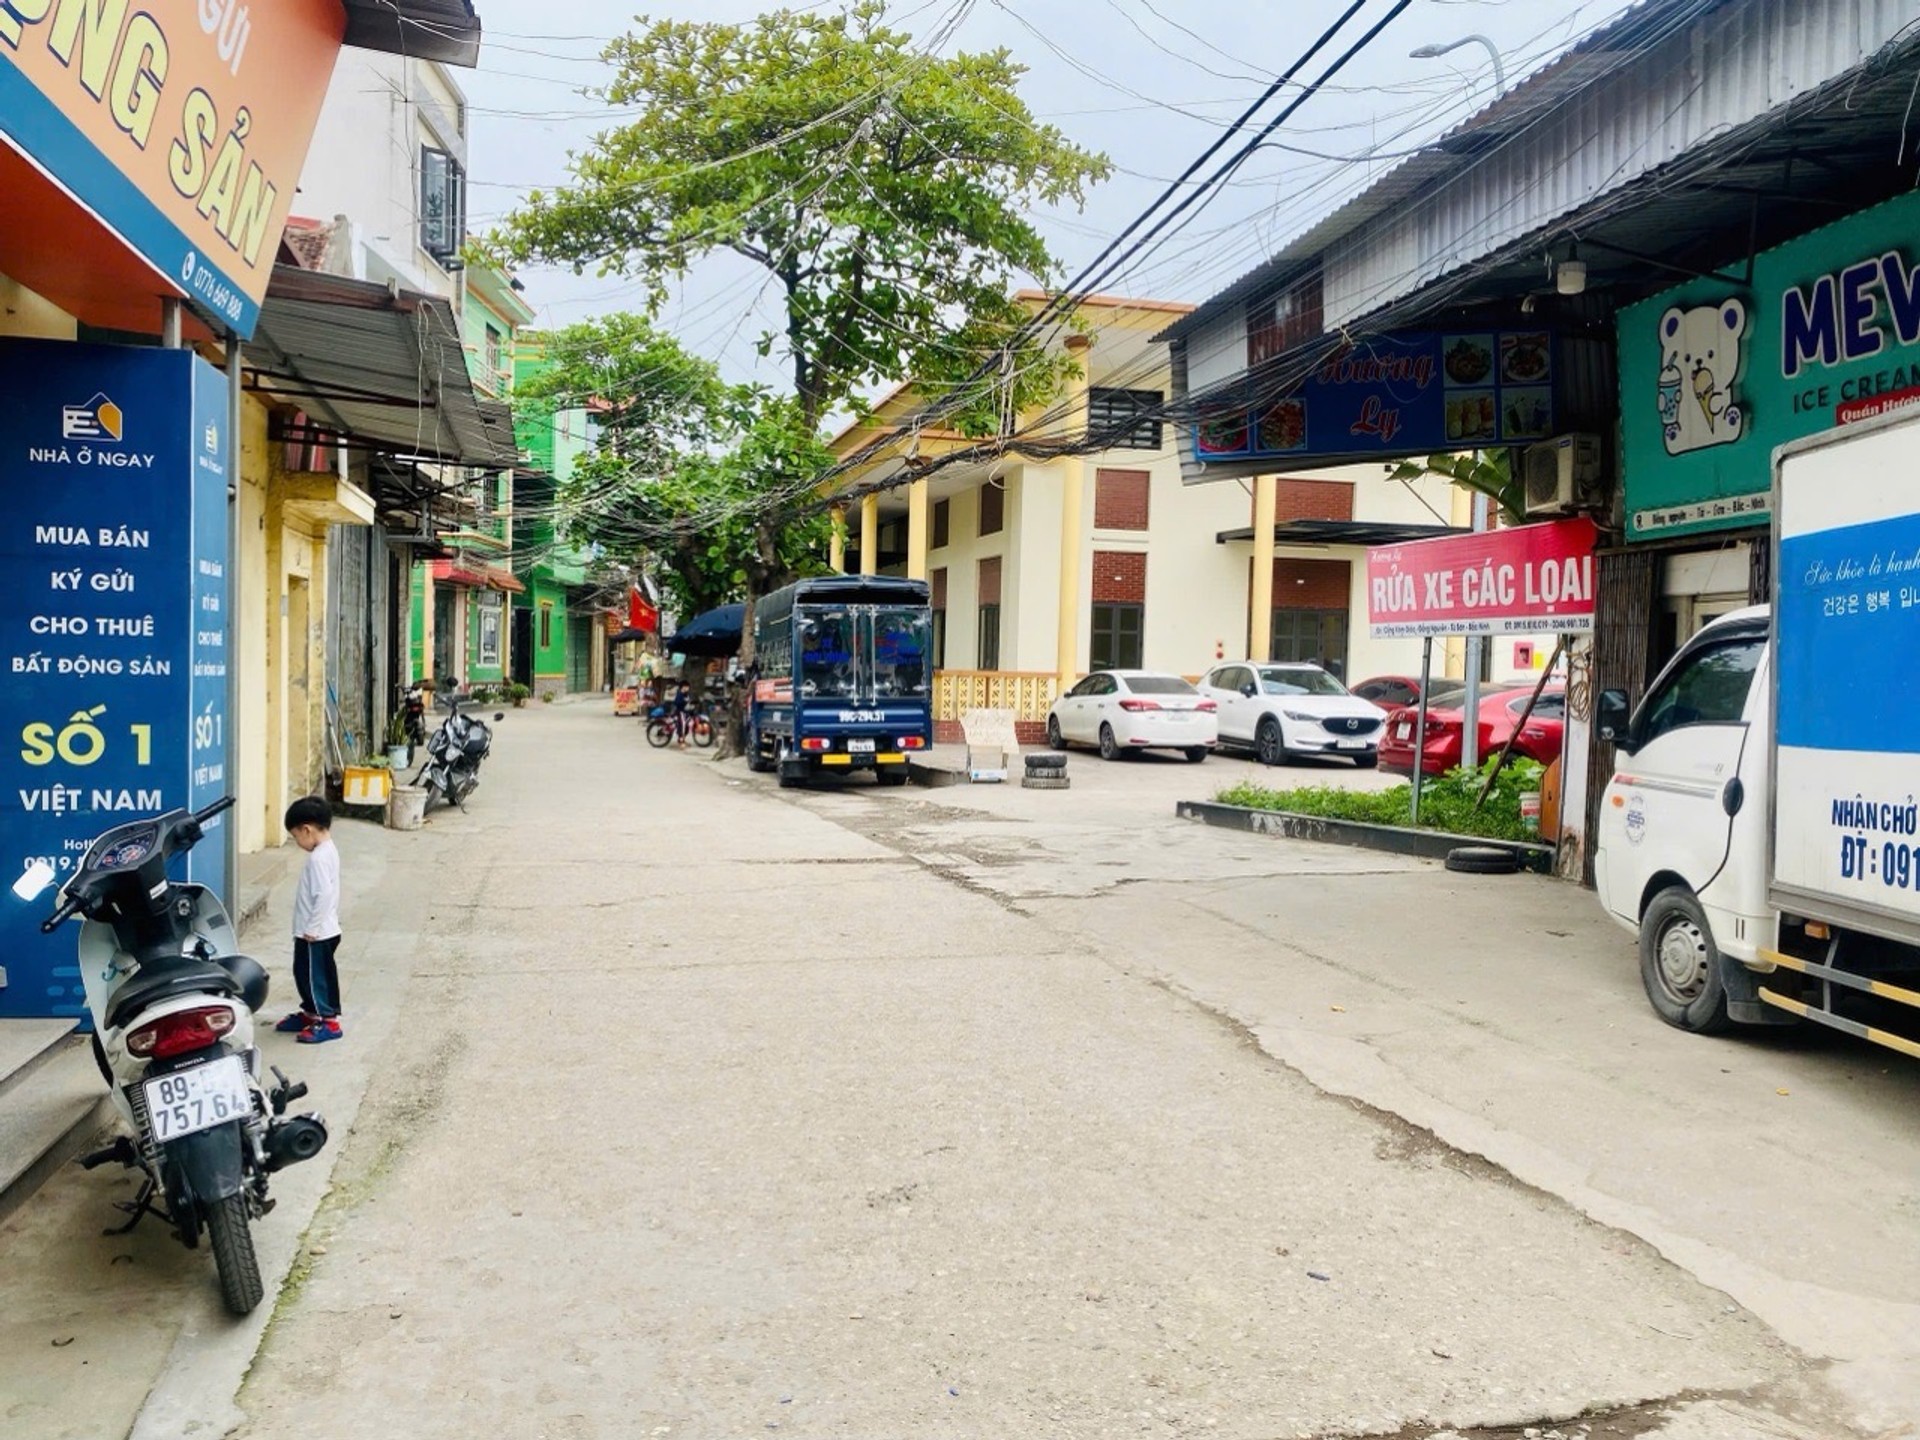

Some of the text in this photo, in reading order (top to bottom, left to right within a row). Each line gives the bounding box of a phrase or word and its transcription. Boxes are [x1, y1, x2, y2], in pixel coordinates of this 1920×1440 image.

[168, 87, 276, 268] SẢN
[1793, 385, 1829, 414] ICE
[1841, 404, 1879, 423] Quán
[29, 445, 155, 468] NHÀ Ở NGAY
[35, 524, 149, 548] MUA BÁN
[51, 567, 134, 592] KÝ GỬI
[1373, 555, 1592, 613] RỬA XE CÁC LOẠI
[1823, 594, 1860, 616] 건강은
[30, 615, 154, 637] CHO THUÊ
[12, 651, 170, 677] BẤT ĐỘNG SẢN
[21, 703, 151, 766] SỐ 1
[195, 700, 222, 750] SỐ 1
[19, 783, 162, 816] VIỆT NAM
[1832, 793, 1917, 836] NHẬN CHỞ
